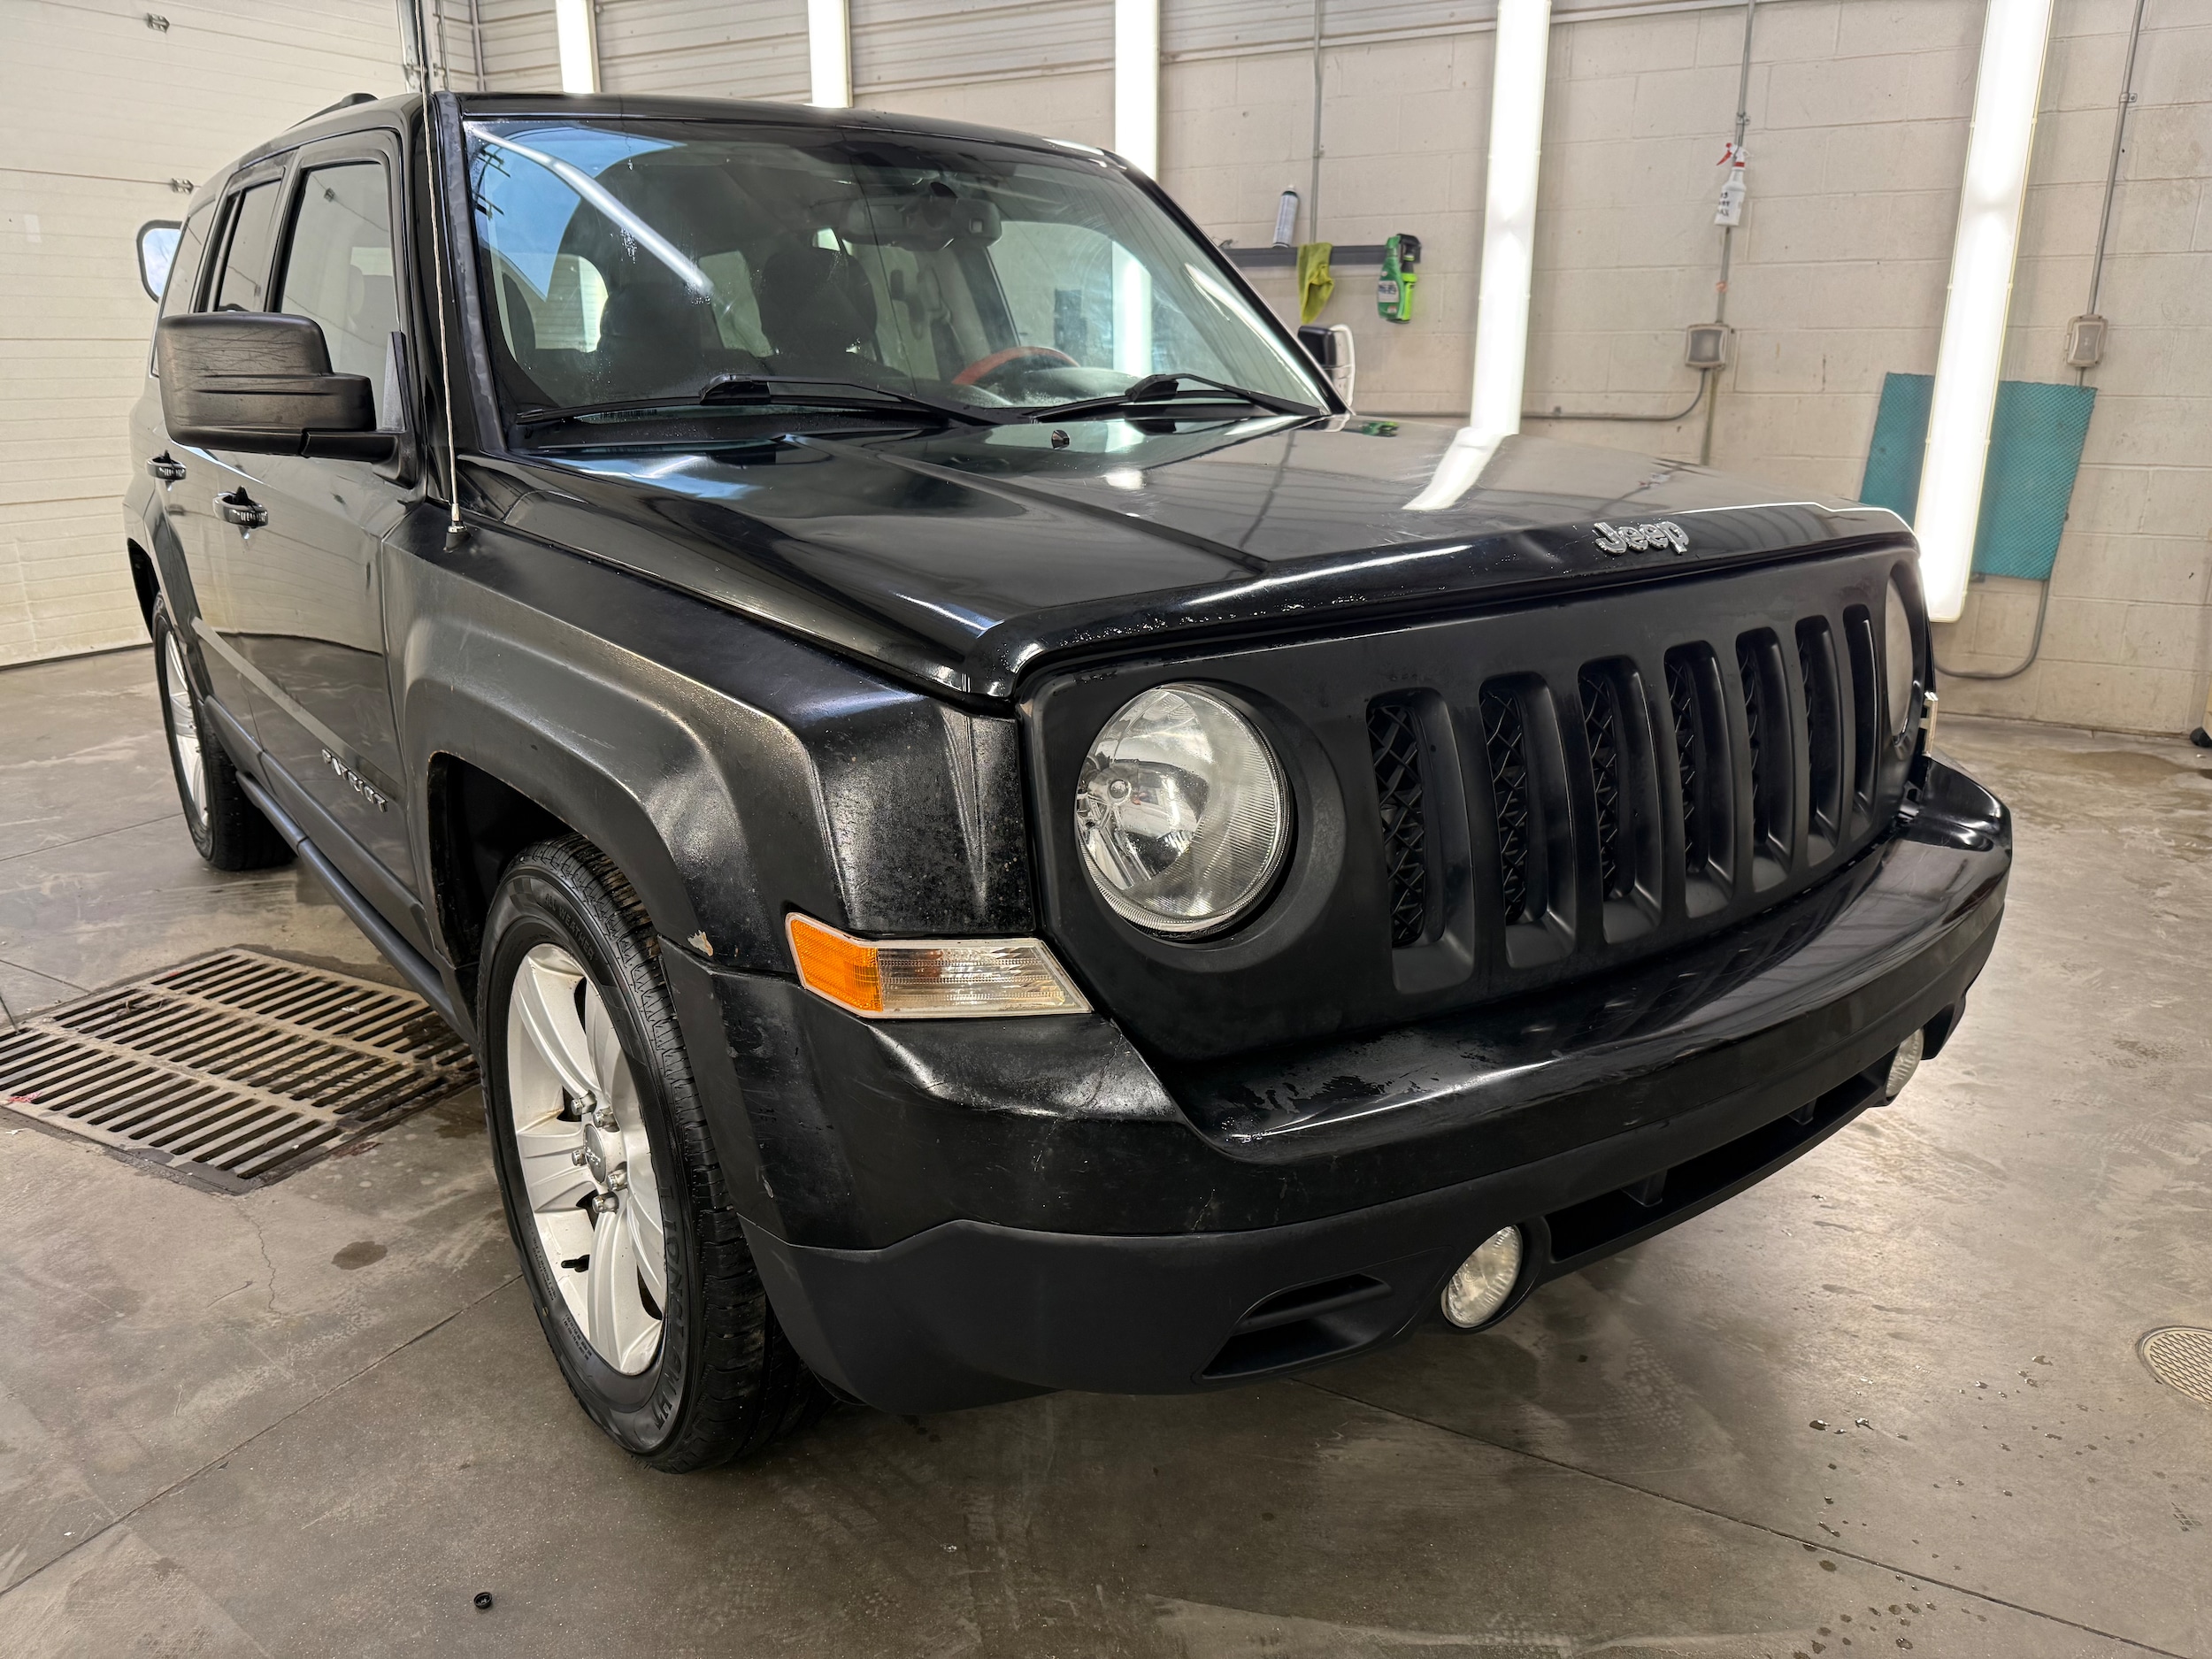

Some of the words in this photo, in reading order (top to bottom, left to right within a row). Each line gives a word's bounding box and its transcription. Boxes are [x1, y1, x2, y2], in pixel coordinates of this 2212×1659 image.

[1594, 520, 1689, 555] Jeep
[321, 749, 388, 812] PATRIOT
[545, 893, 557, 911] ALL
[559, 905, 595, 961] WEATHER
